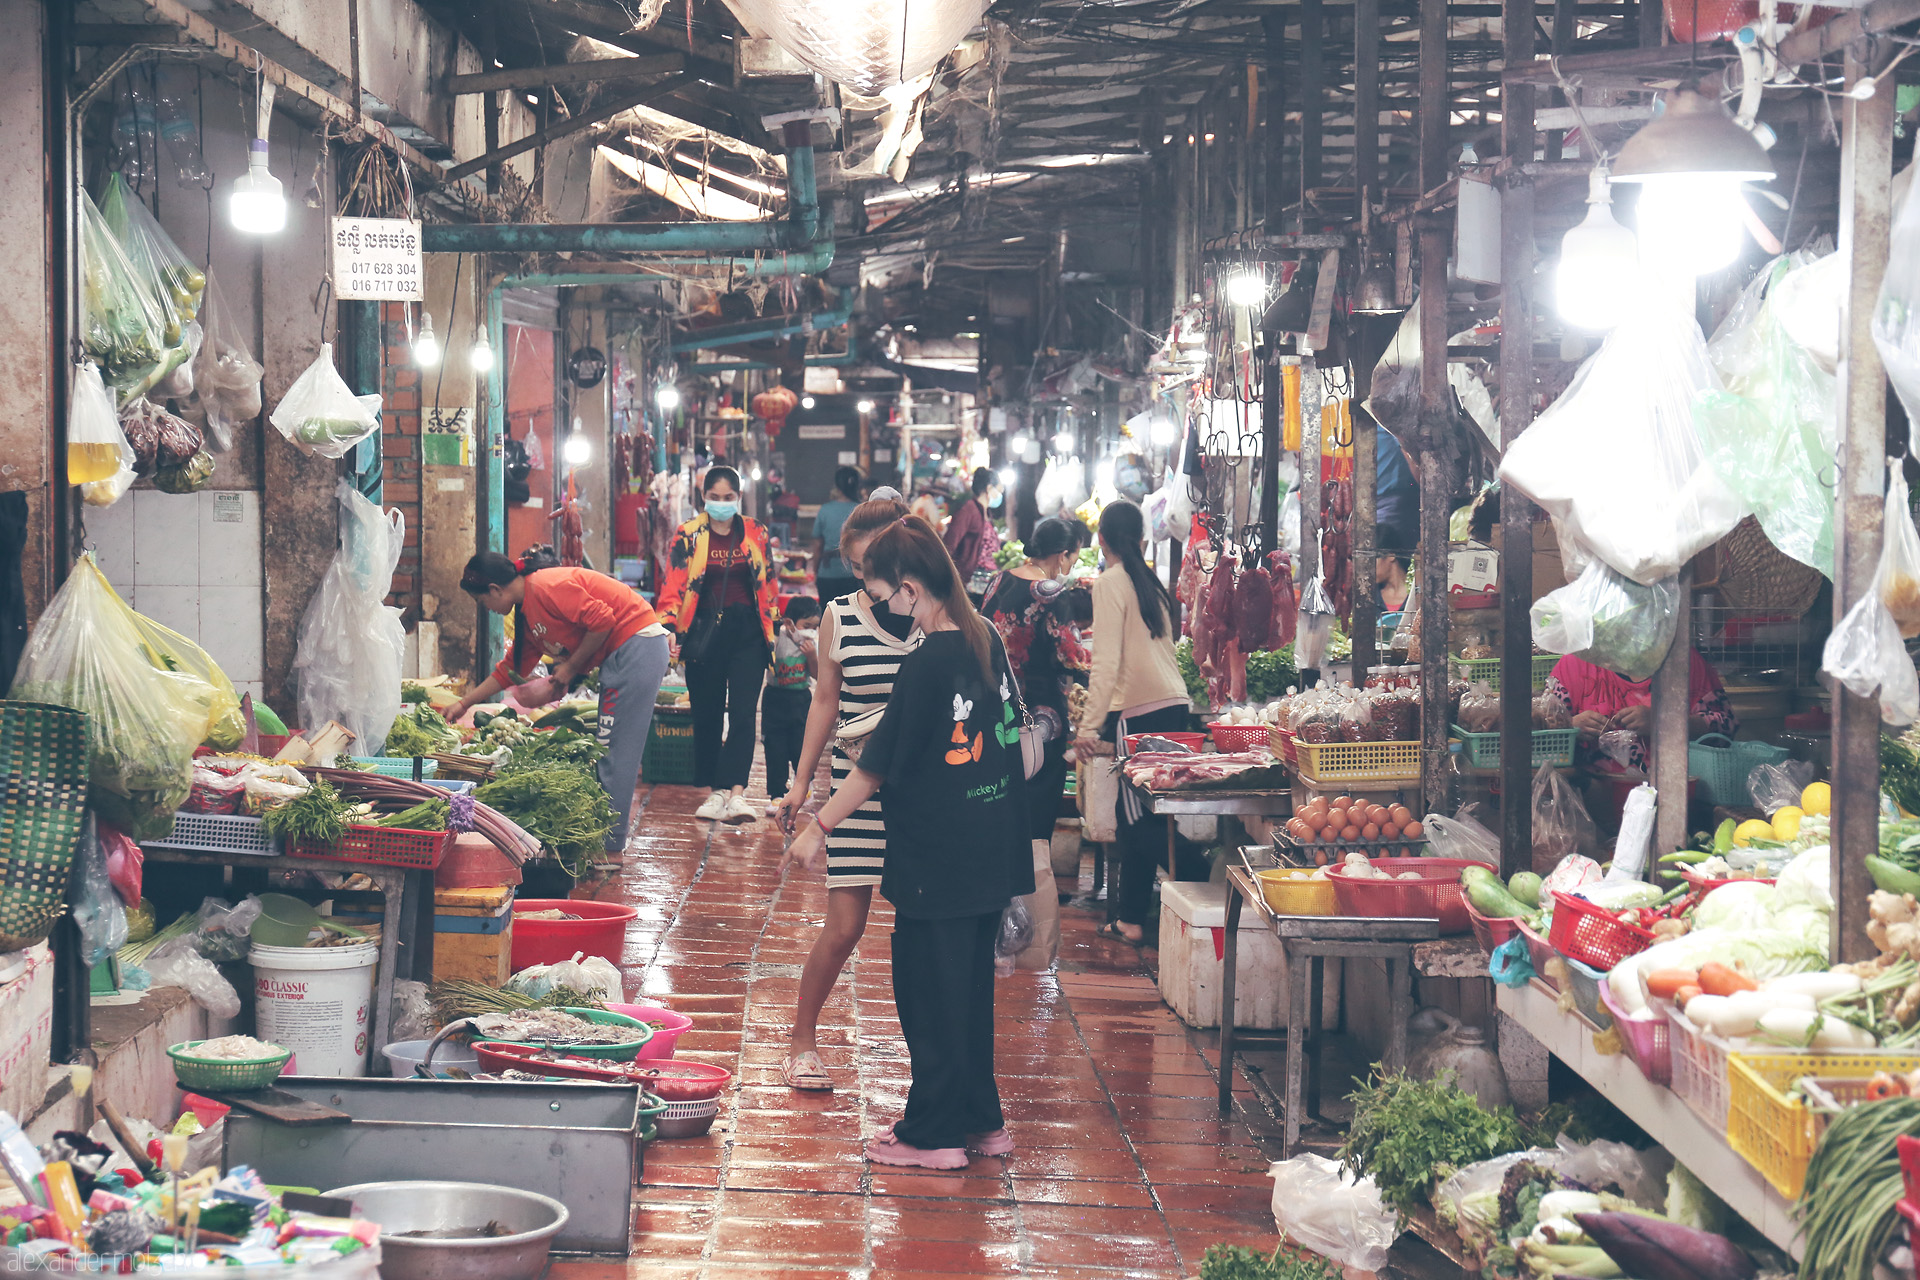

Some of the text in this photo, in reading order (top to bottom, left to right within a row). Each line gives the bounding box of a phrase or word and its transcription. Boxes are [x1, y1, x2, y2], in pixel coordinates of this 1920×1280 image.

[351, 262, 370, 274] 017
[374, 262, 393, 275] 628
[396, 263, 416, 275] 304
[352, 279, 371, 291] 016
[374, 280, 393, 292] 717
[397, 280, 417, 292] 032
[967, 783, 998, 799] Mickey
[271, 980, 309, 993] CLASSIC
[277, 992, 305, 1000] EXTERIOR
